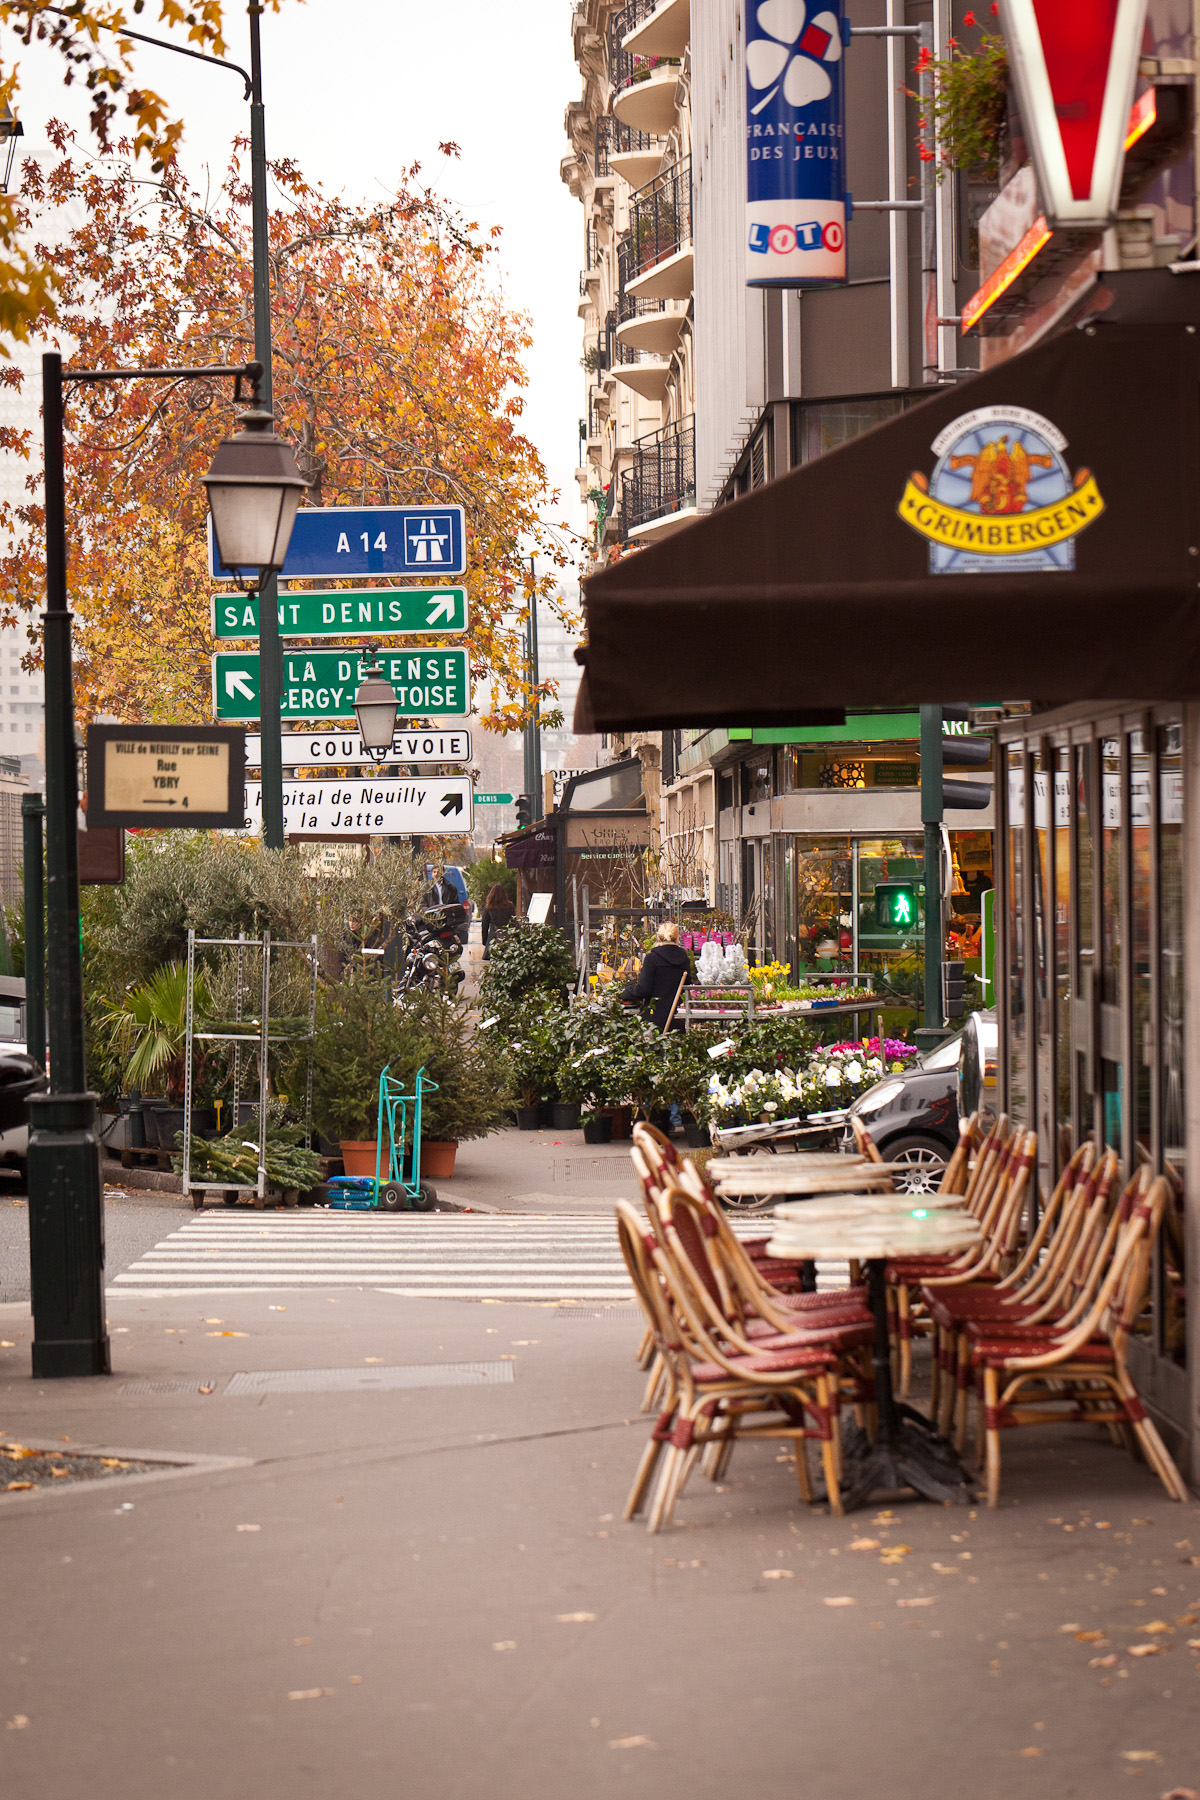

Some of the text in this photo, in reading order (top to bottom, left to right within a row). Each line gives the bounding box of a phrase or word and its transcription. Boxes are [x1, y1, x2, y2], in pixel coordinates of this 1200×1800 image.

[750, 146, 839, 160] DES JEUX
[749, 221, 843, 254] LOTO
[915, 500, 1087, 546] GRIMBERGEN
[337, 531, 388, 553] A 14
[224, 600, 402, 627] SANT DENIS
[288, 661, 317, 682] LA
[115, 743, 220, 756] VILLE de NEUILLY sur SEINE
[157, 759, 177, 771] Rue
[152, 776, 180, 789] YBRY
[182, 796, 189, 808] 4
[331, 789, 352, 805] de
[360, 787, 427, 807] Neuilly
[477, 795, 498, 803] DENIS
[301, 812, 318, 828] la
[331, 811, 384, 827] Jatte
